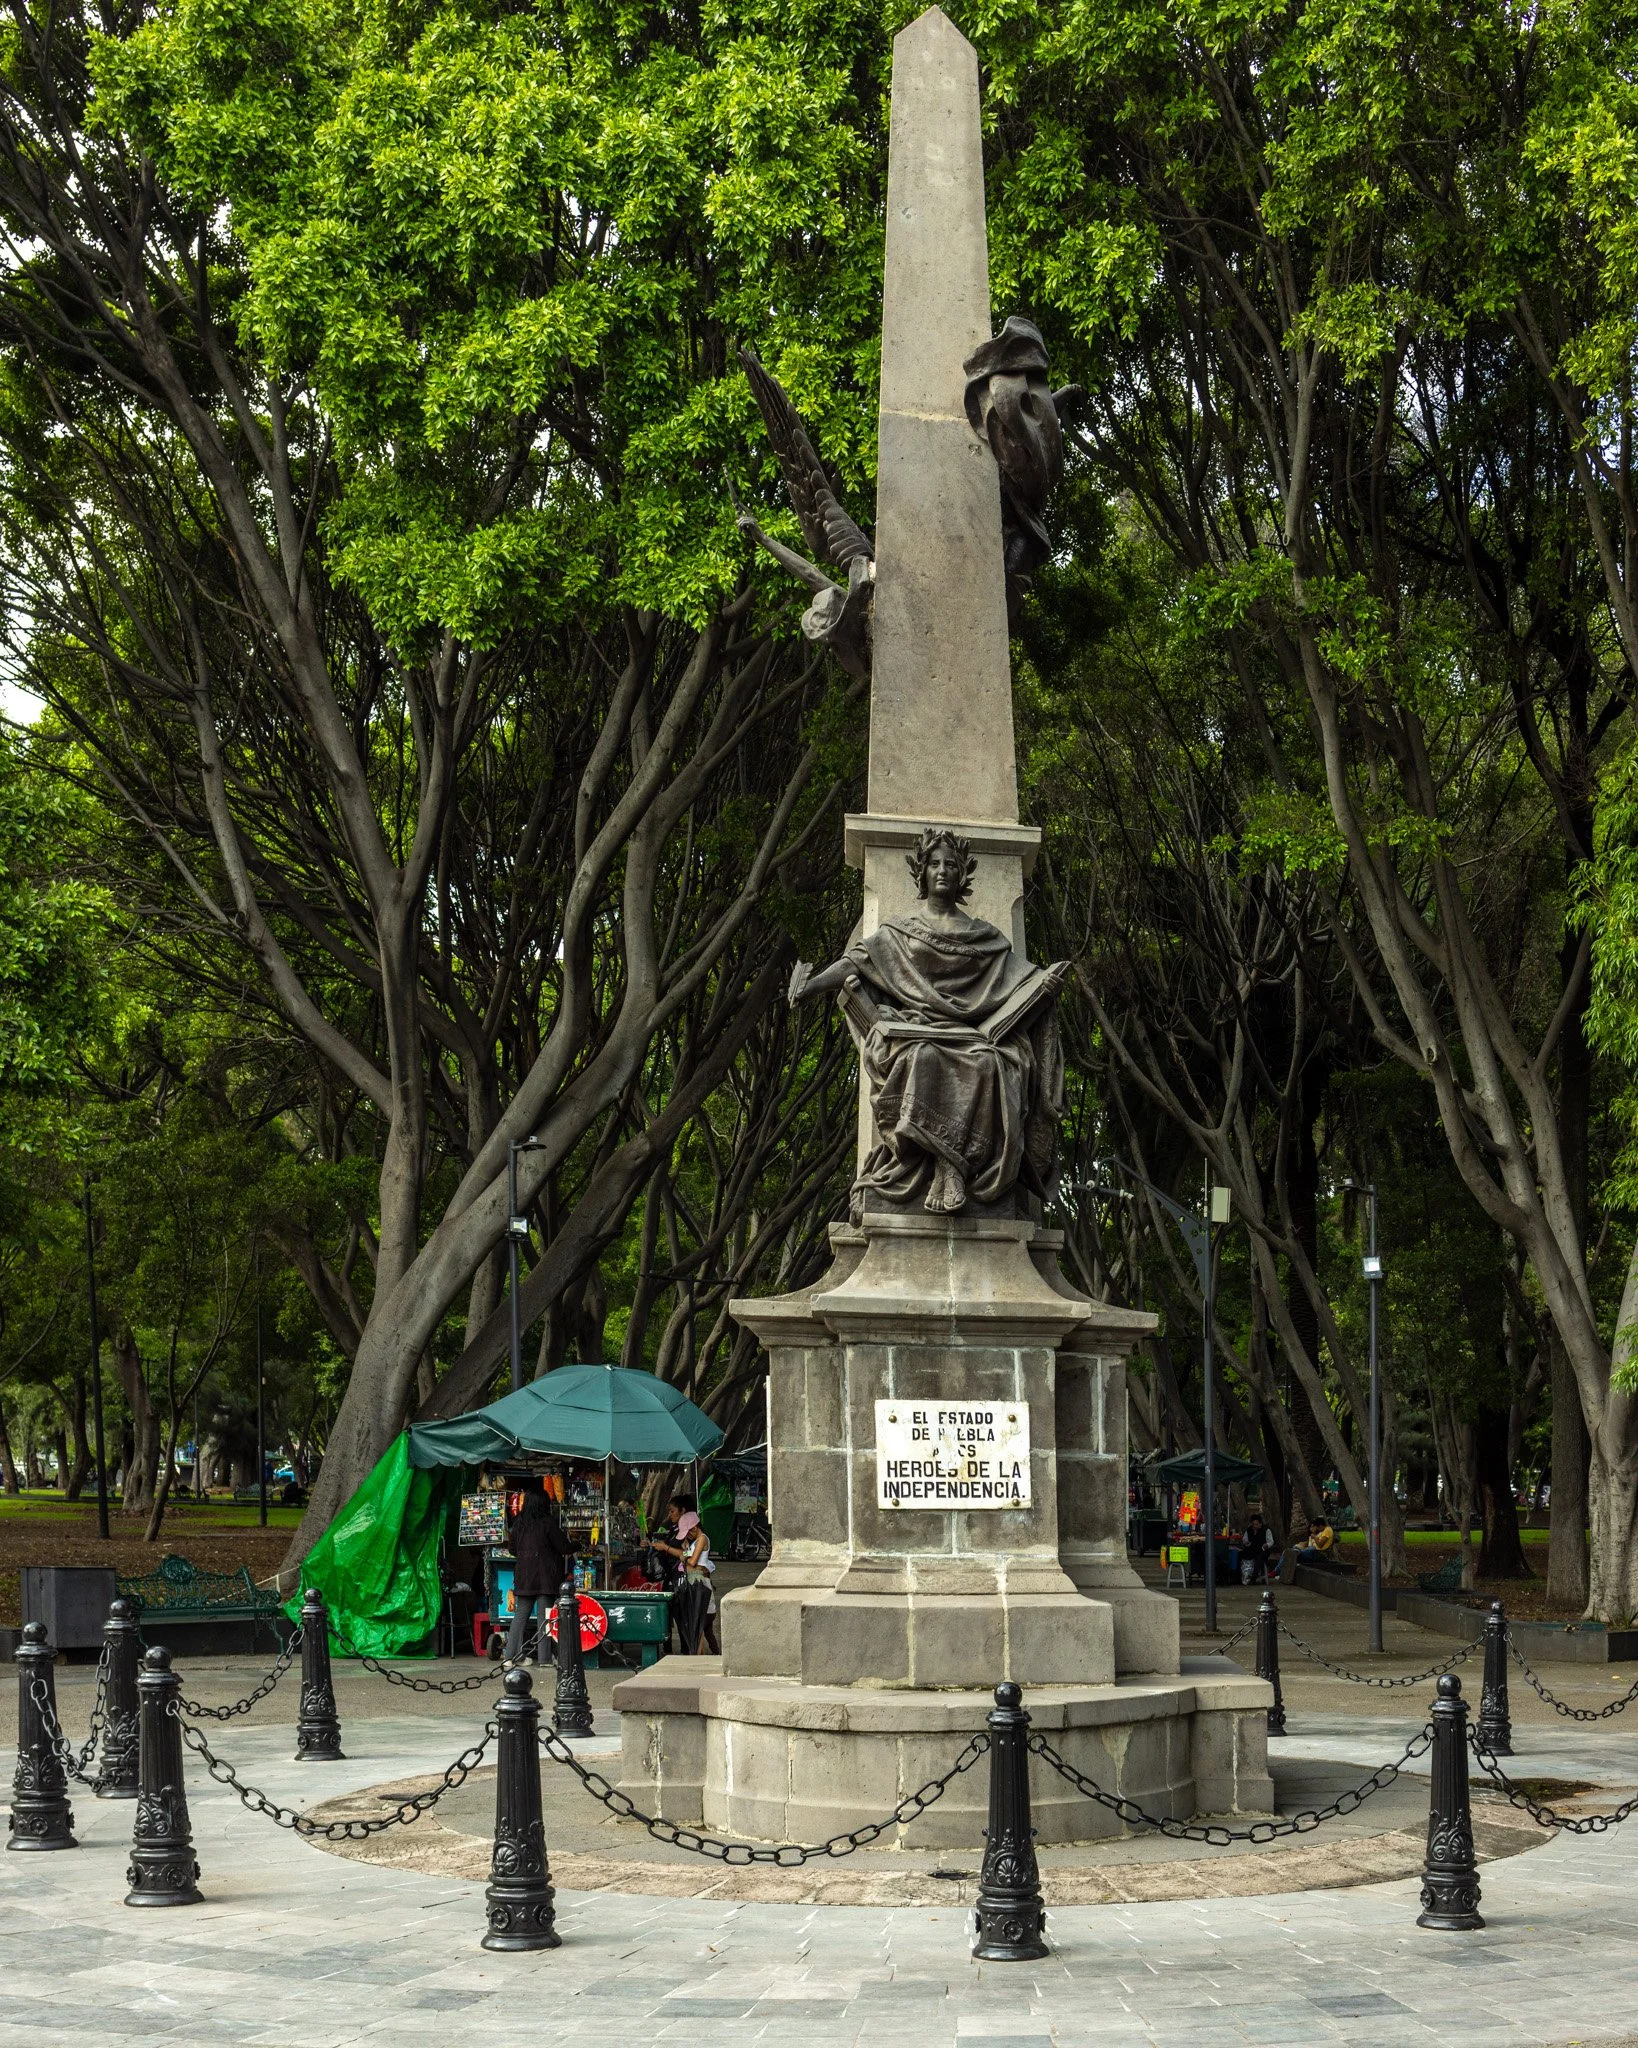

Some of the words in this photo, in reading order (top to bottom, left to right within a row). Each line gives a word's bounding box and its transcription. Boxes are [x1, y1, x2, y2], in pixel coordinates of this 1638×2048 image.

[913, 1411, 928, 1424] EL
[938, 1411, 994, 1425] ESTADO
[912, 1428, 930, 1441] DE
[938, 1428, 995, 1441] PEBLA
[887, 1460, 958, 1478] HEROES
[967, 1461, 990, 1478] DE
[999, 1461, 1022, 1478] LA
[883, 1480, 1026, 1499] INDEPENDENCIA.
